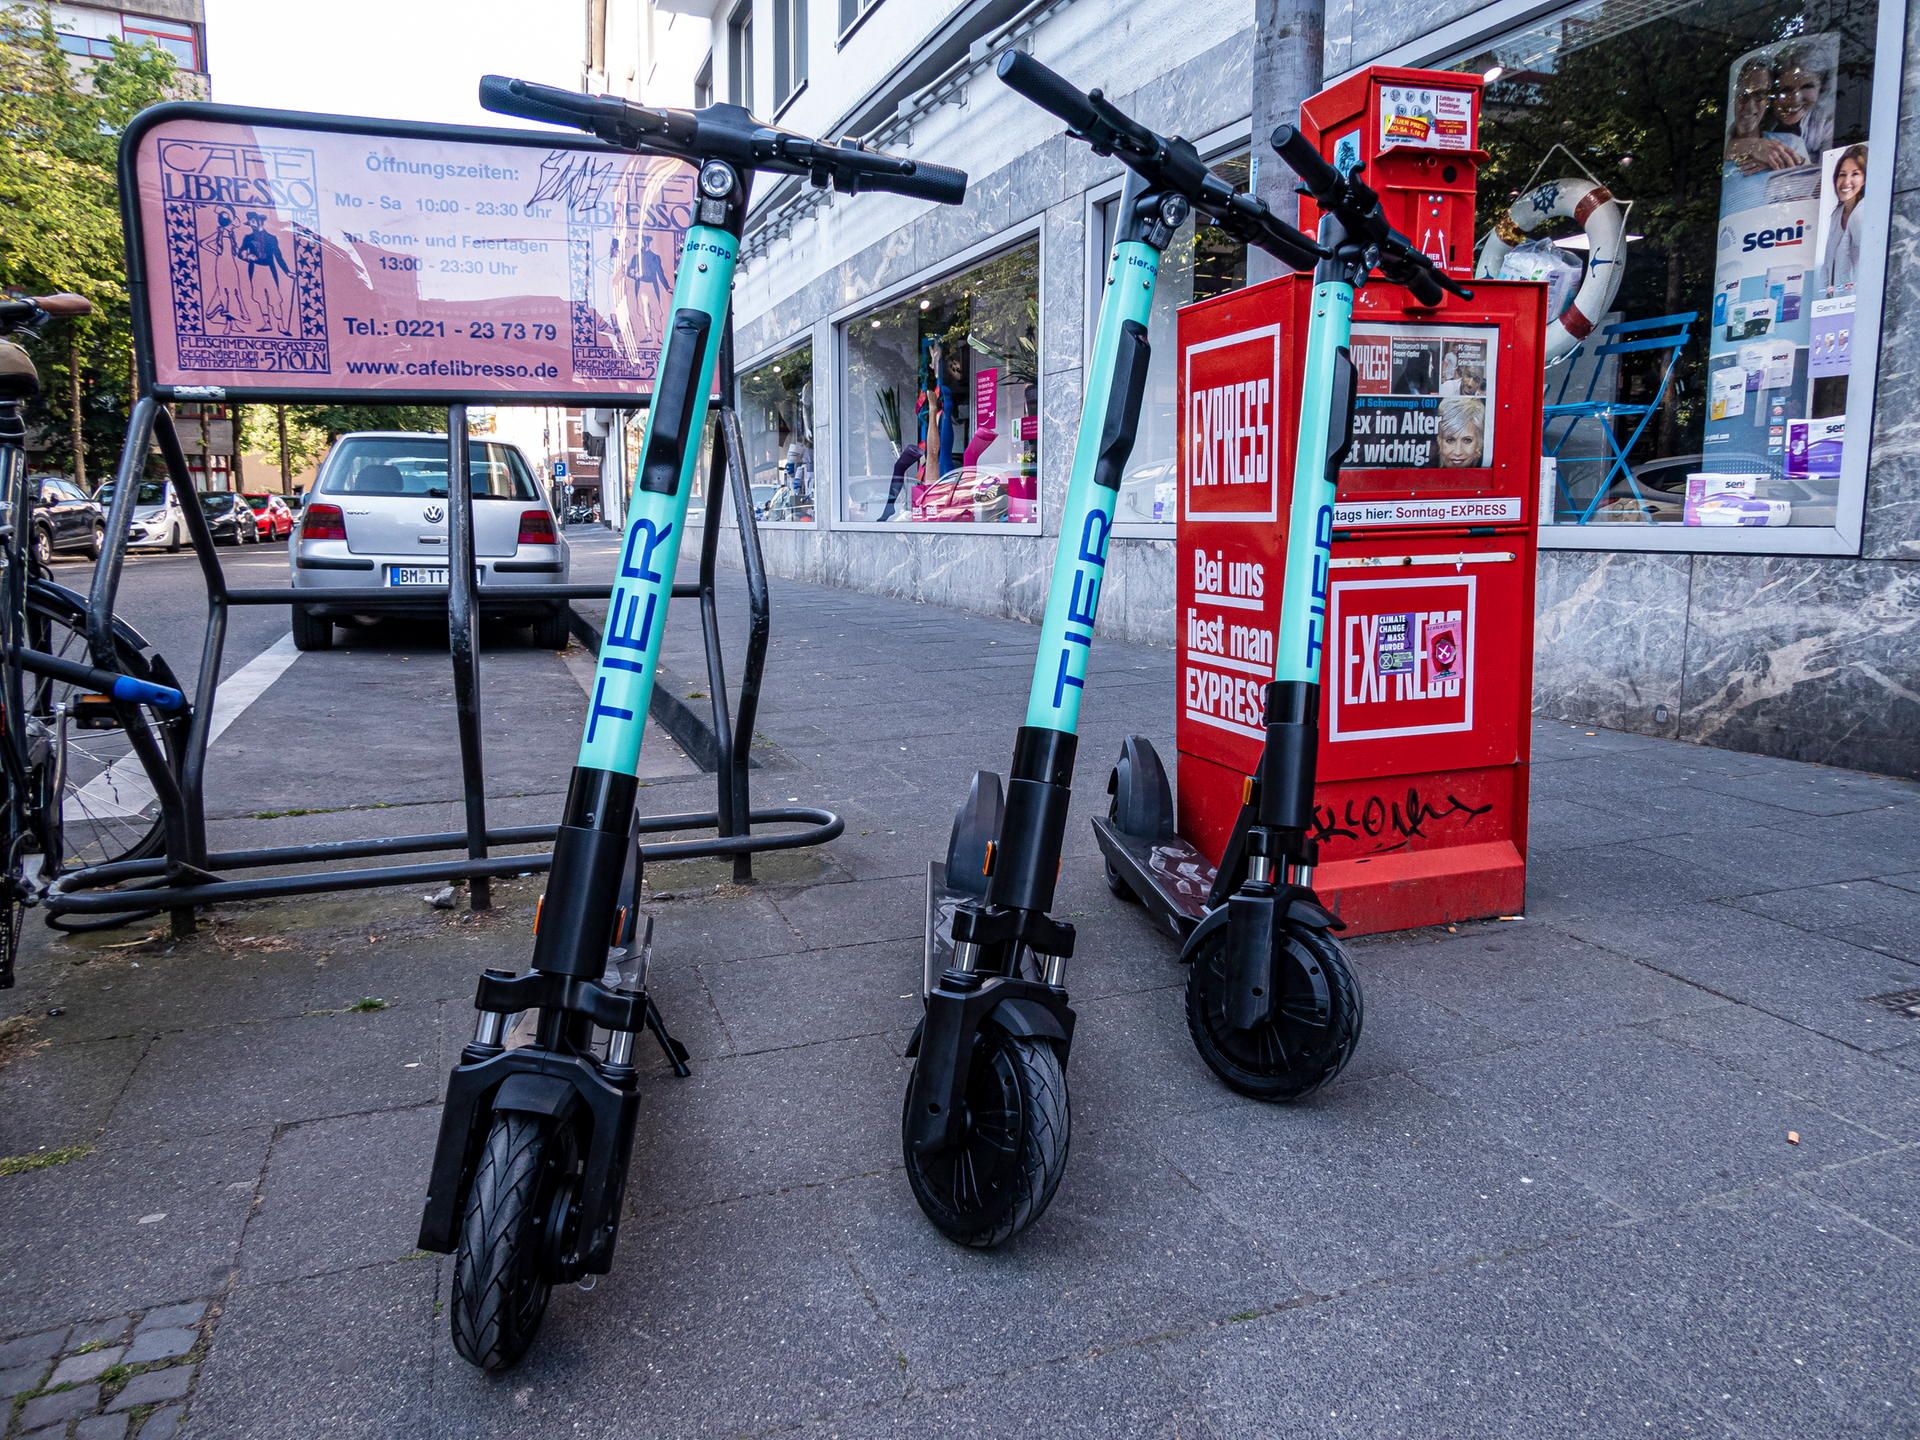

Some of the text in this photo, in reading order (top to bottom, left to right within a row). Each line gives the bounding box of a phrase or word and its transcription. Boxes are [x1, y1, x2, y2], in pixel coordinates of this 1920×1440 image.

[366, 151, 519, 182] Öffnungszeiten:
[164, 171, 315, 208] LIBRESSO
[335, 192, 362, 208] Mo
[380, 195, 402, 210] Sa
[416, 198, 459, 213] 10:00
[475, 202, 518, 217] 23:30
[523, 205, 552, 219] Uhr
[570, 199, 691, 230] LIBESSO
[344, 230, 549, 255] an Sonn- und Feiertagen
[1742, 219, 1804, 252] seni
[379, 256, 423, 271] 13:00
[440, 259, 483, 274] 23:30
[489, 262, 518, 276] Uhr
[1752, 307, 1769, 317] seni
[343, 317, 388, 336] Tel.:
[395, 319, 446, 338] 0221
[469, 321, 495, 339] 23
[501, 322, 526, 340] 73
[532, 323, 557, 341] 79
[181, 349, 258, 362] GEGENÜBER DER
[278, 351, 327, 371] KÖLN
[1350, 343, 1389, 380] XPRESS
[1772, 352, 1788, 361] seni
[346, 359, 559, 379] www.cafelibresso.de
[1729, 383, 1742, 391] seni
[1192, 378, 1270, 486] EXPRESS
[1352, 410, 1443, 435] ex im Alter
[1826, 423, 1846, 434] sen
[1363, 439, 1431, 466] wichtig!
[556, 464, 564, 475] P
[1725, 480, 1745, 489] seni
[1366, 508, 1392, 520] hier:
[1396, 504, 1507, 519] Sonntag-EXPRESS
[401, 570, 444, 583] BM TT
[1195, 549, 1264, 598] Bei uns
[1052, 509, 1113, 708] TIER
[1379, 615, 1406, 624] CLIMATE
[1379, 624, 1405, 633] CHANGE
[586, 518, 672, 743] TIER
[1187, 607, 1273, 665] liest man
[1386, 633, 1405, 642] MASS
[1379, 642, 1405, 652] MURDER
